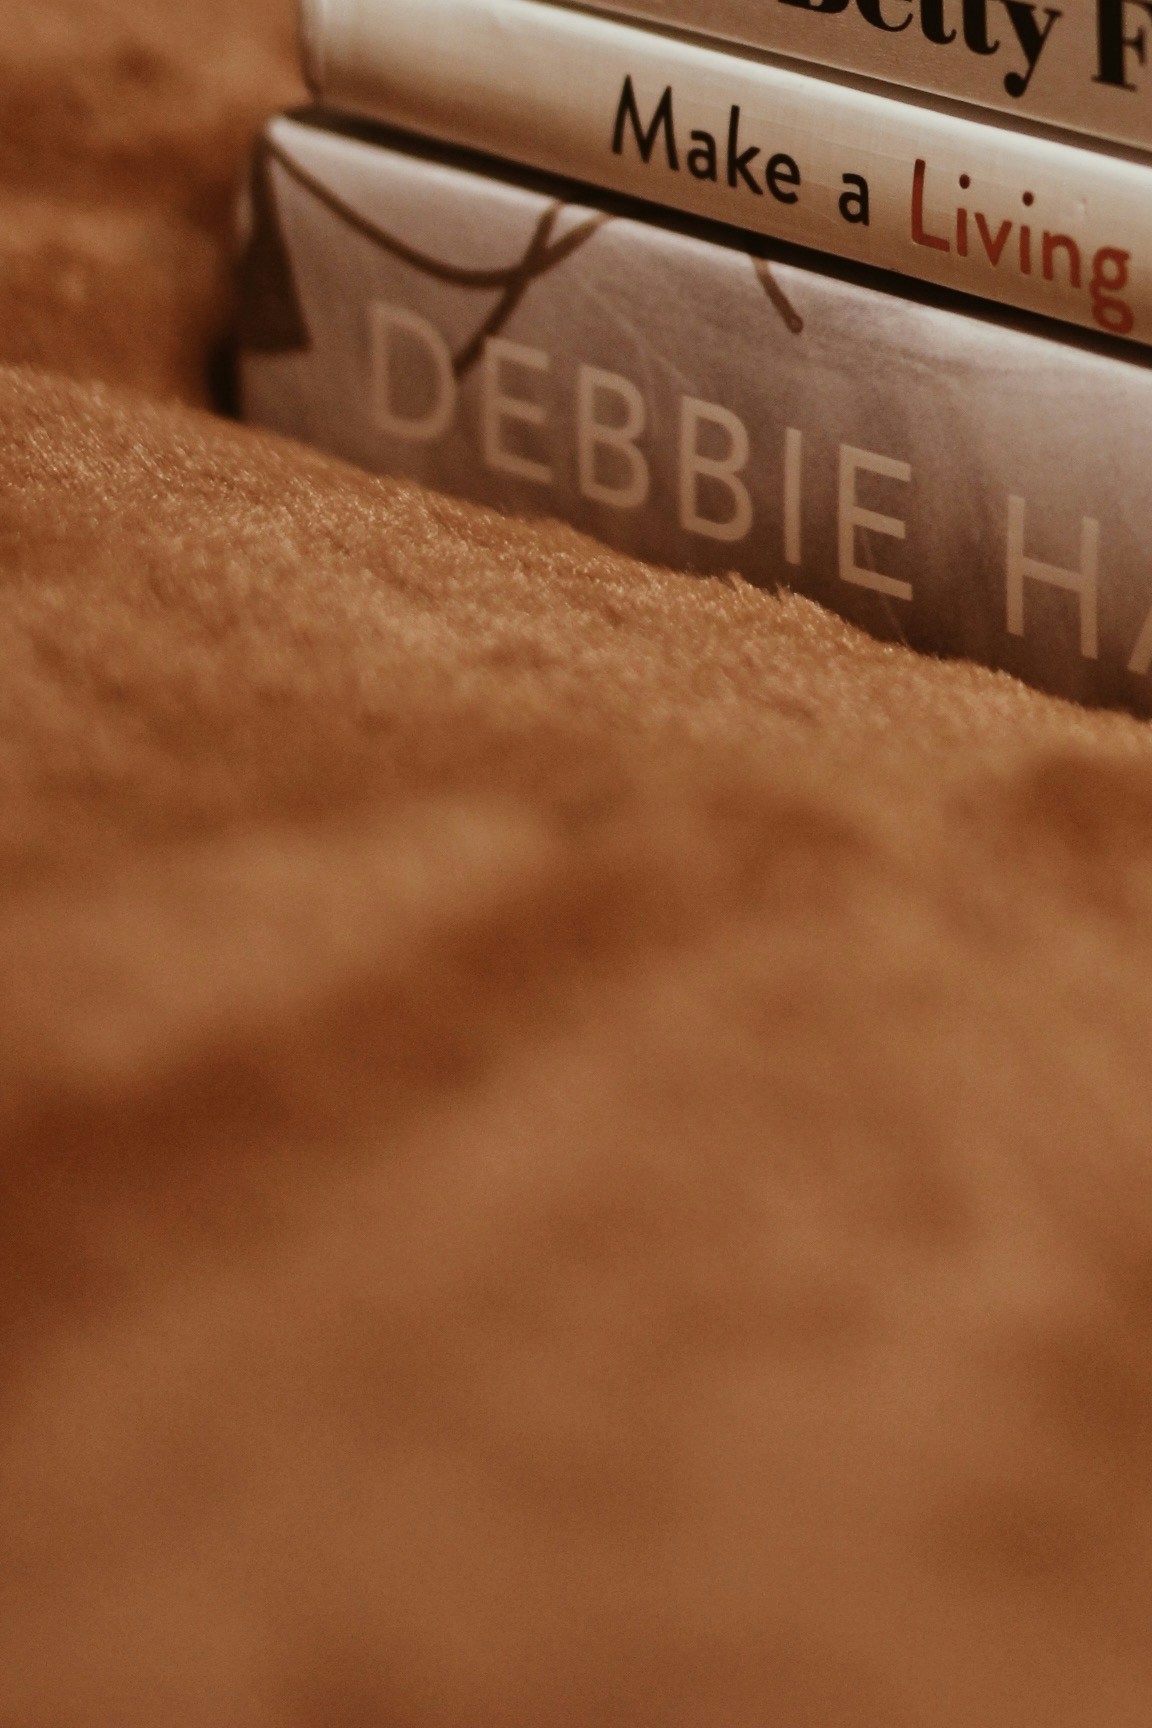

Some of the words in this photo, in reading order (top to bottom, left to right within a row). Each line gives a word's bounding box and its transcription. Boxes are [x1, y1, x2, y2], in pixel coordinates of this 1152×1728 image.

[612, 75, 800, 204] Make
[838, 172, 870, 226] a
[911, 159, 1133, 335] Living
[366, 301, 912, 601] DEBBIE
